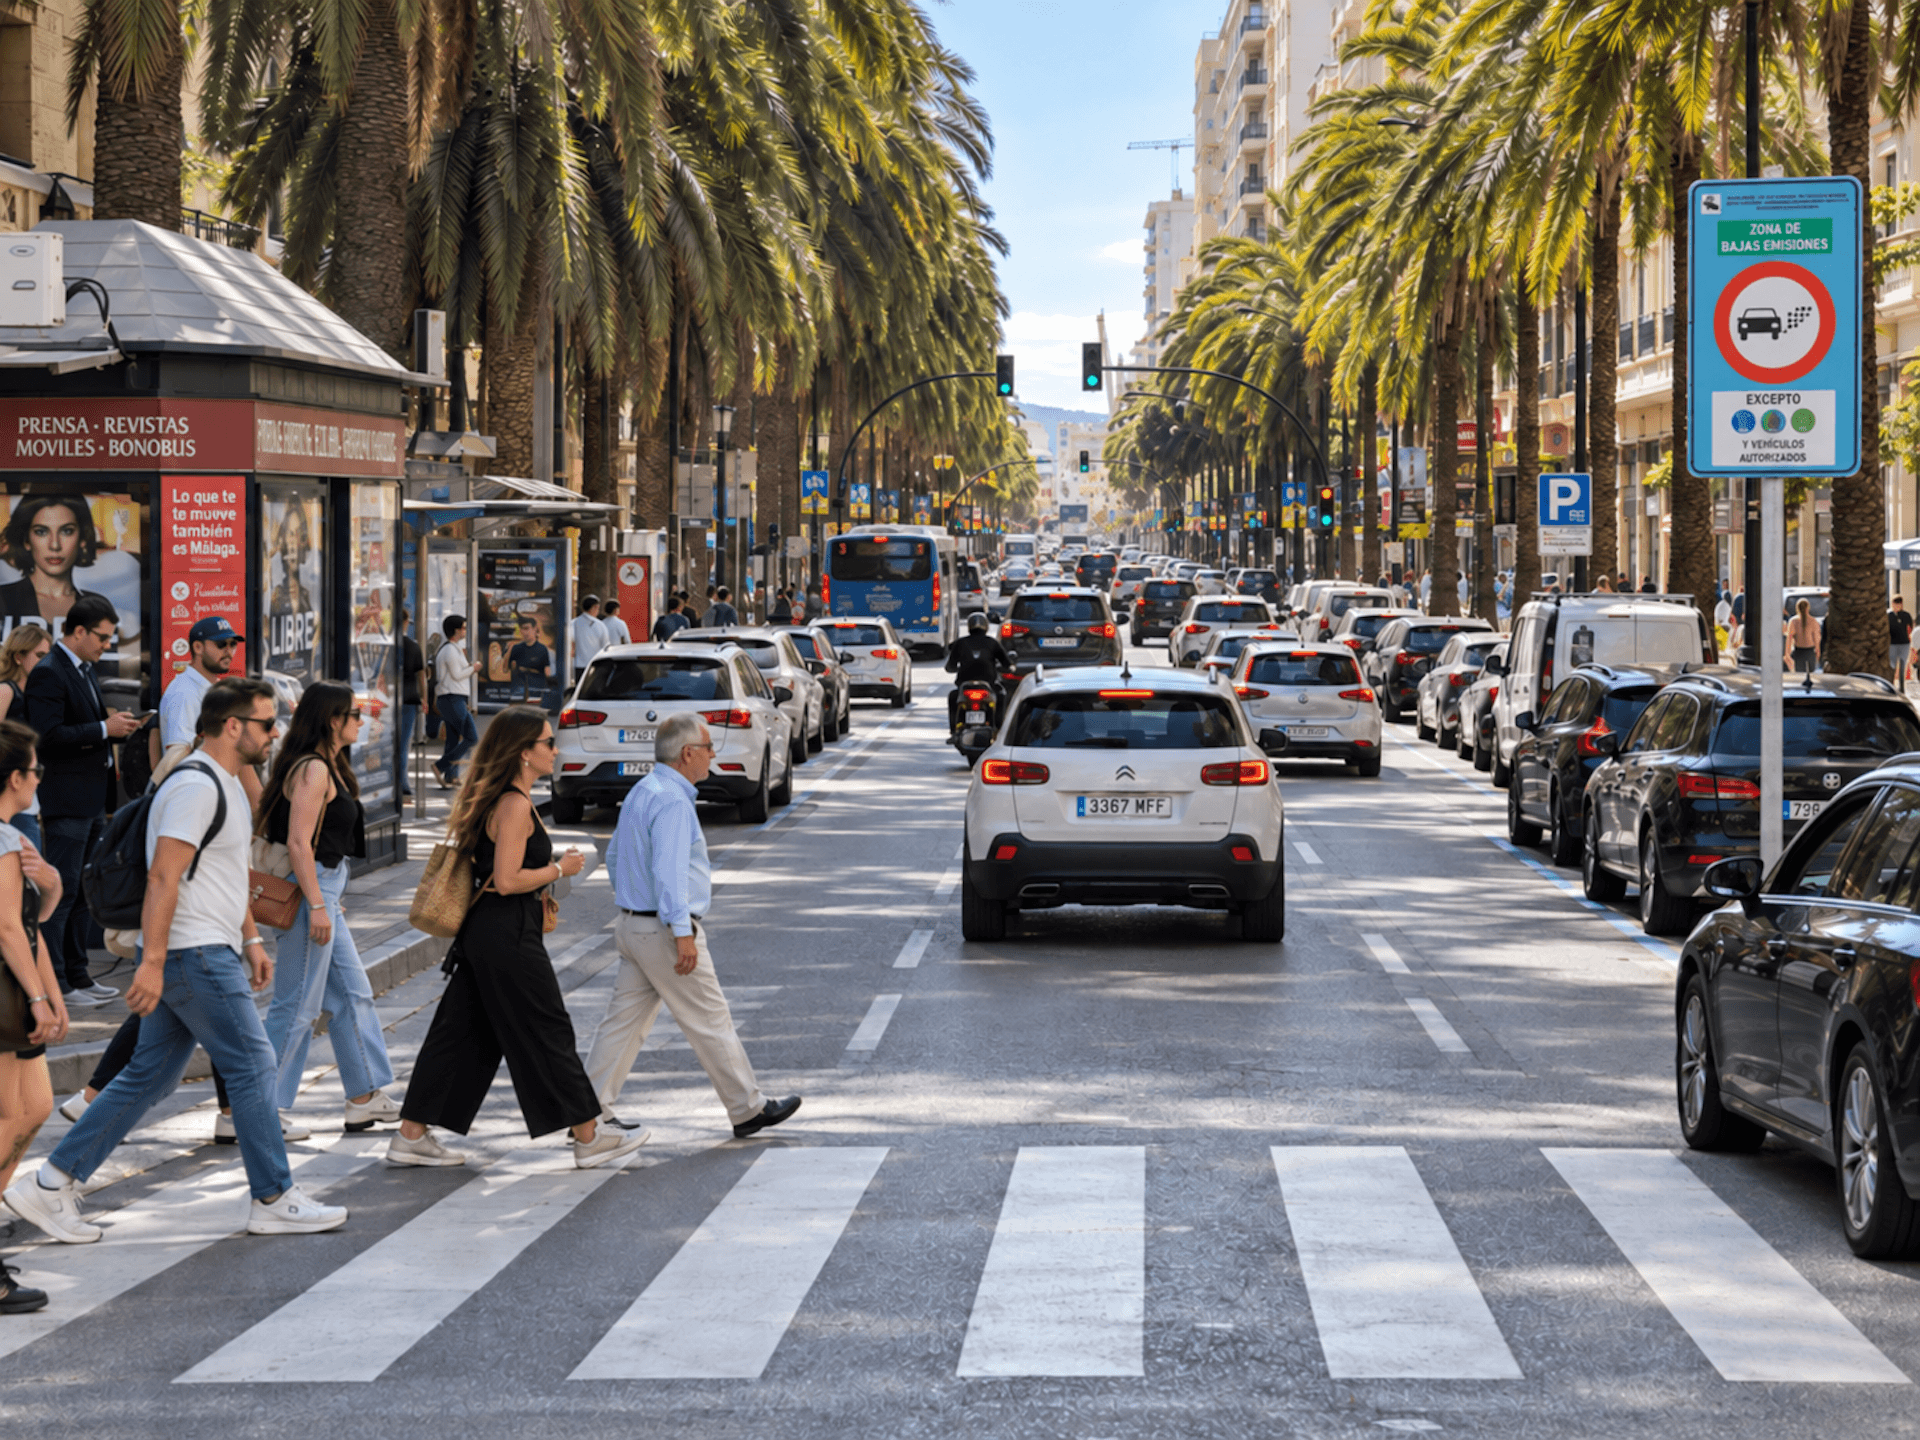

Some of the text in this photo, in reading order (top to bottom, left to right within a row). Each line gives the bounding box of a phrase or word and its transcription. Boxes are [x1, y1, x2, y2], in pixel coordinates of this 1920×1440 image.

[1749, 222, 1801, 235] ZONA DE
[1720, 238, 1828, 252] BAJAS EMISIONES
[1746, 393, 1801, 405] EXCEPTO
[18, 416, 190, 434] PRENSA REVISTAS
[15, 439, 196, 457] MOVILES BONOBUS
[1742, 440, 1749, 449] Y
[1739, 453, 1807, 463] AUTORIZADOS
[172, 488, 236, 507] Lo que te
[1549, 478, 1581, 521] P
[172, 507, 187, 521] te
[172, 523, 233, 538] también
[172, 544, 187, 555] es
[271, 611, 315, 656] LIBRE
[1089, 798, 1166, 813] 3367 MFF
